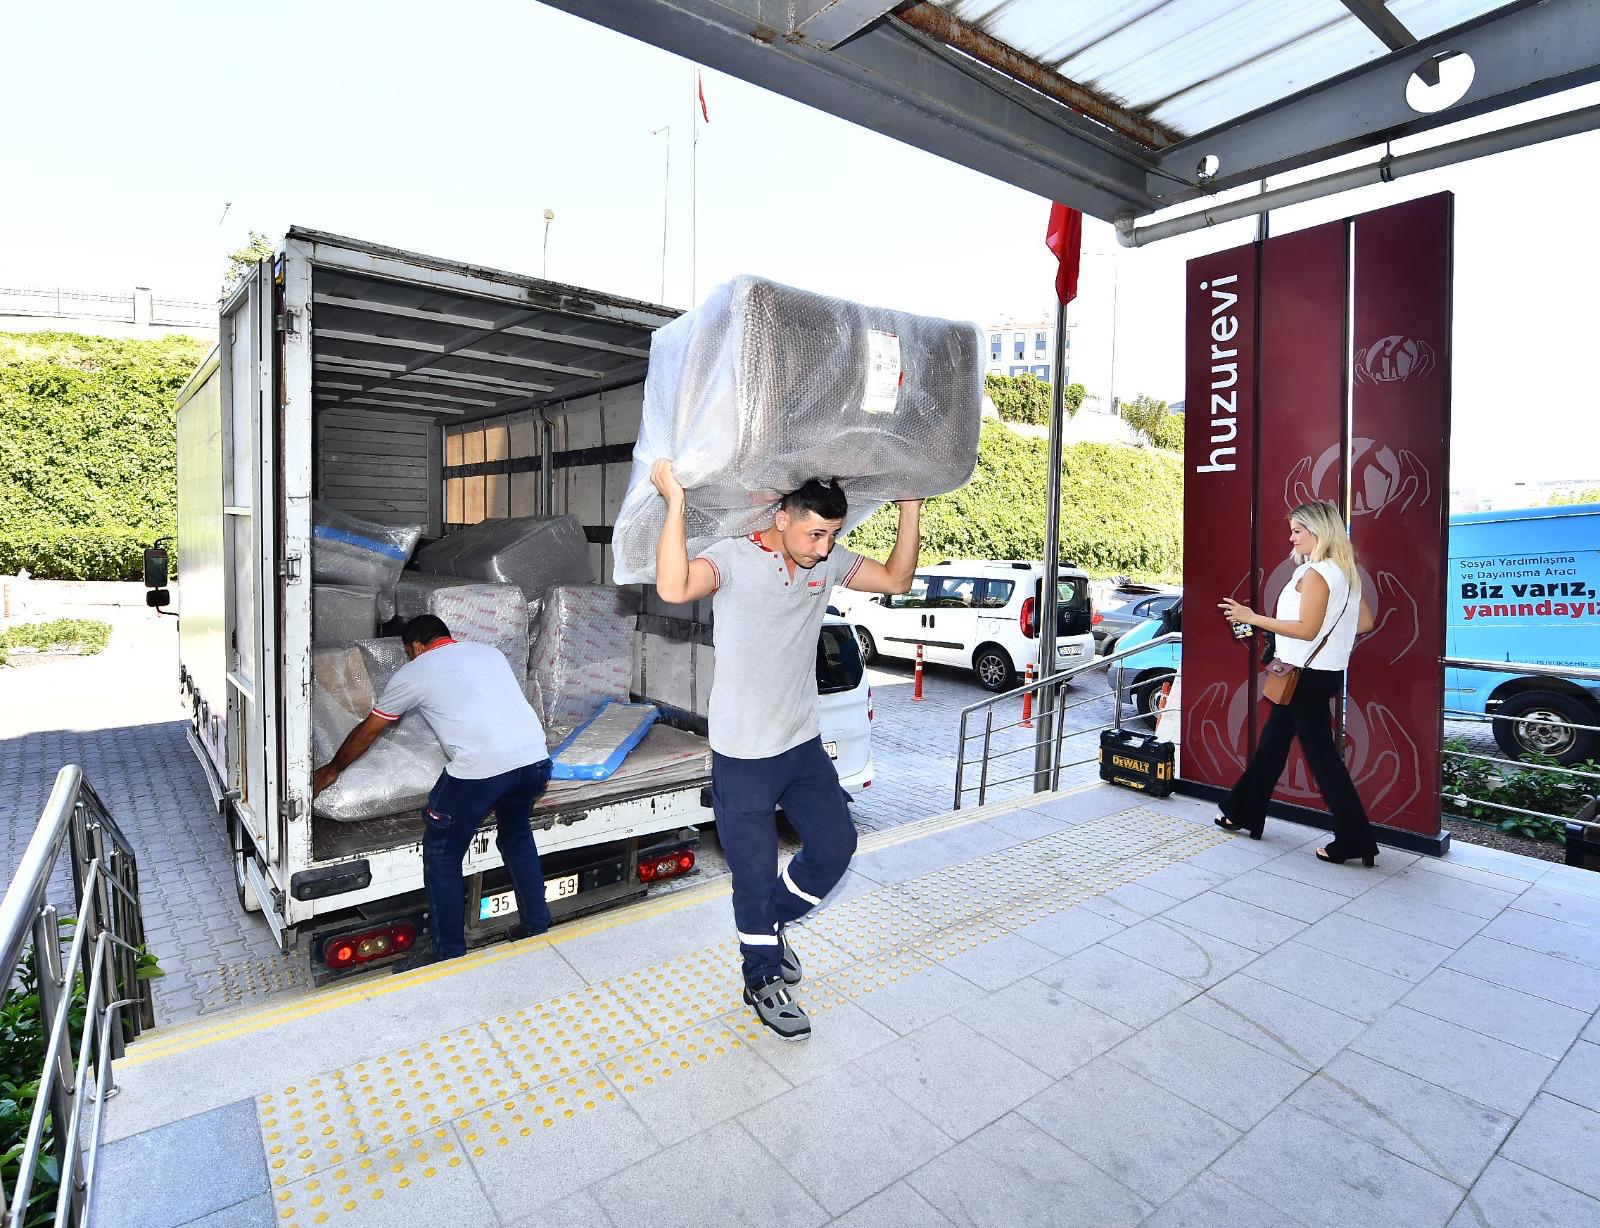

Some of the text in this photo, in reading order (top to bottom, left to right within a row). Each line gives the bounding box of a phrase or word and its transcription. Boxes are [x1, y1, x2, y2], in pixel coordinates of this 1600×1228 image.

[1197, 274, 1239, 473] huzurevi
[1460, 555, 1575, 569] Sosyal Yardımlaşma
[1461, 568, 1576, 580] ve Dayanışma Aracı
[1461, 581, 1596, 599] Biz varız,
[1462, 600, 1600, 621] yanındayı
[492, 878, 576, 914] 35 59
